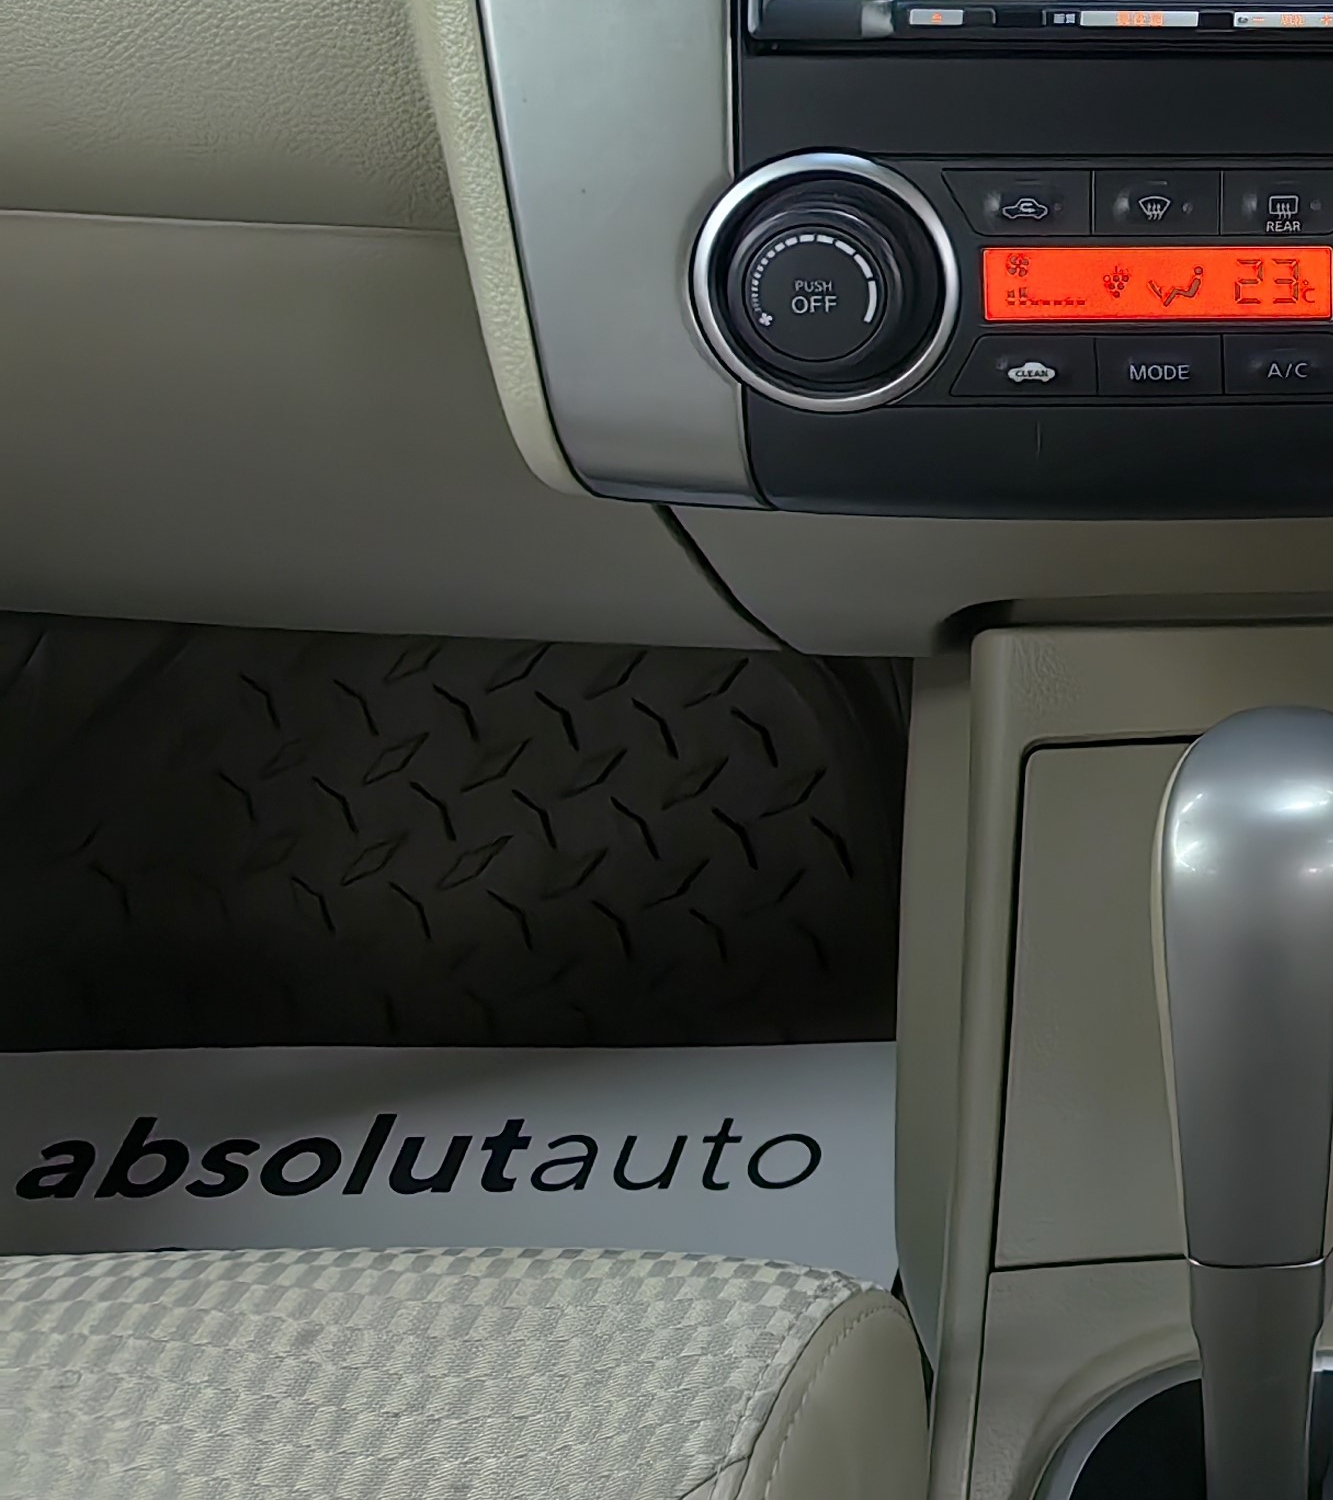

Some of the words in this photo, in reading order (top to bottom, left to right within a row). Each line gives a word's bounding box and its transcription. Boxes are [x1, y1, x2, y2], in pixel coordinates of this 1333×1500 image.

[1265, 220, 1301, 233] REAR
[794, 279, 833, 293] PUSH
[791, 295, 838, 314] OFF
[1129, 363, 1191, 382] MODE
[1267, 362, 1309, 379] A/C
[14, 1112, 824, 1200] absolutauto
